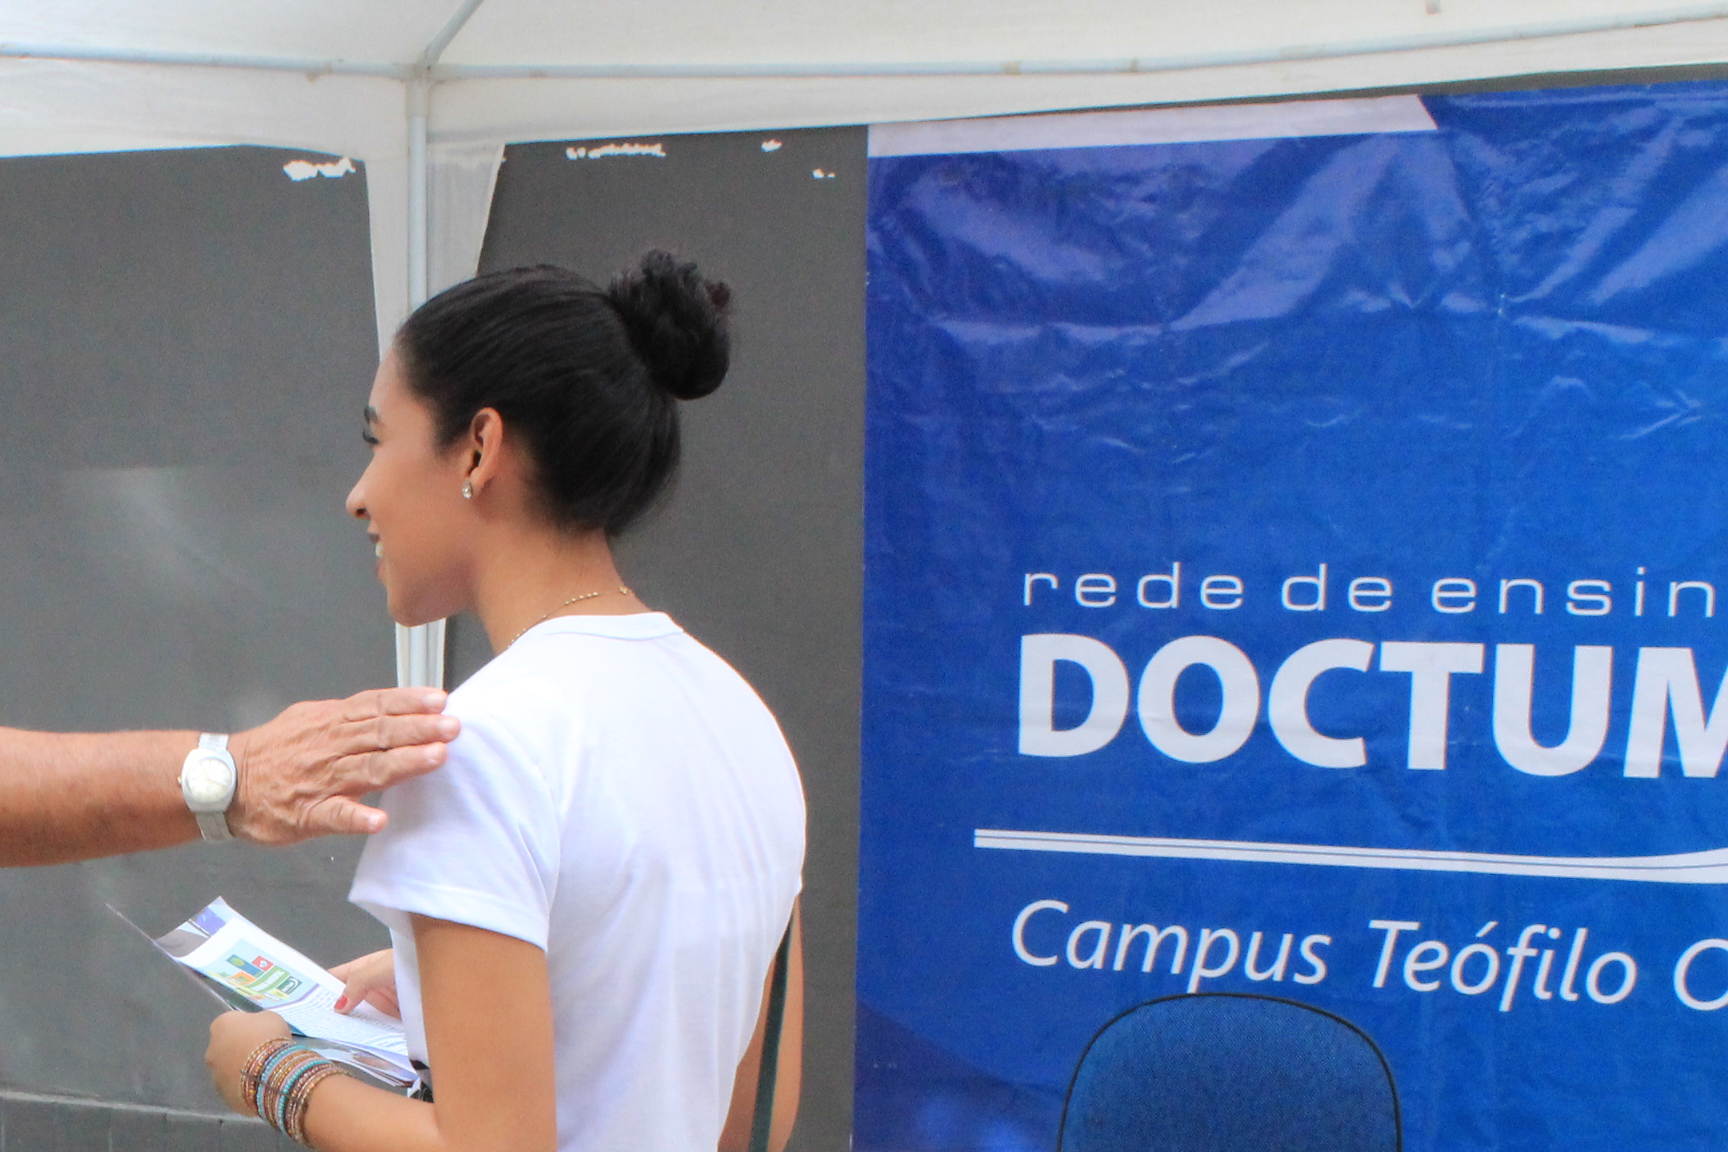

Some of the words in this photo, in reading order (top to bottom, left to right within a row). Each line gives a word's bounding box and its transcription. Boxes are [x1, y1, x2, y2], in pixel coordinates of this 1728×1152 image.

[1023, 561, 1245, 611] rede
[1281, 562, 1394, 613] de
[1432, 566, 1717, 618] ensin
[1017, 631, 1728, 780] DOCTUM
[1011, 898, 1333, 995] Campus
[1368, 918, 1639, 1013] Teófilo
